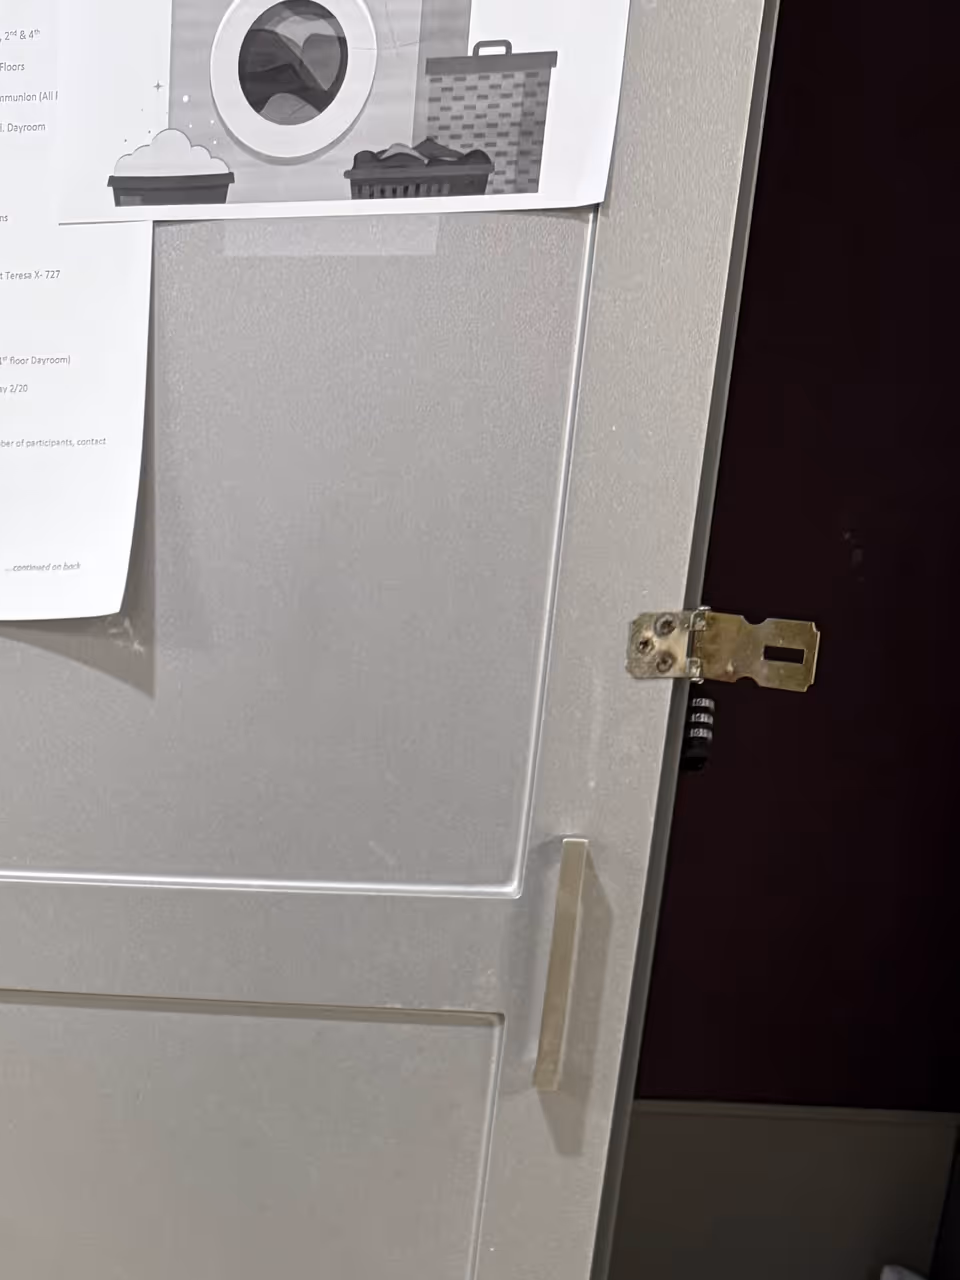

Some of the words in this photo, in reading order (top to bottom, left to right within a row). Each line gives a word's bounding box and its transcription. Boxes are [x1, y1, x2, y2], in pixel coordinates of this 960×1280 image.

[0, 62, 25, 72] Floors
[39, 91, 53, 102] (All
[7, 123, 46, 133] Dayroom
[5, 271, 32, 280] Teresa
[45, 270, 61, 279] 727
